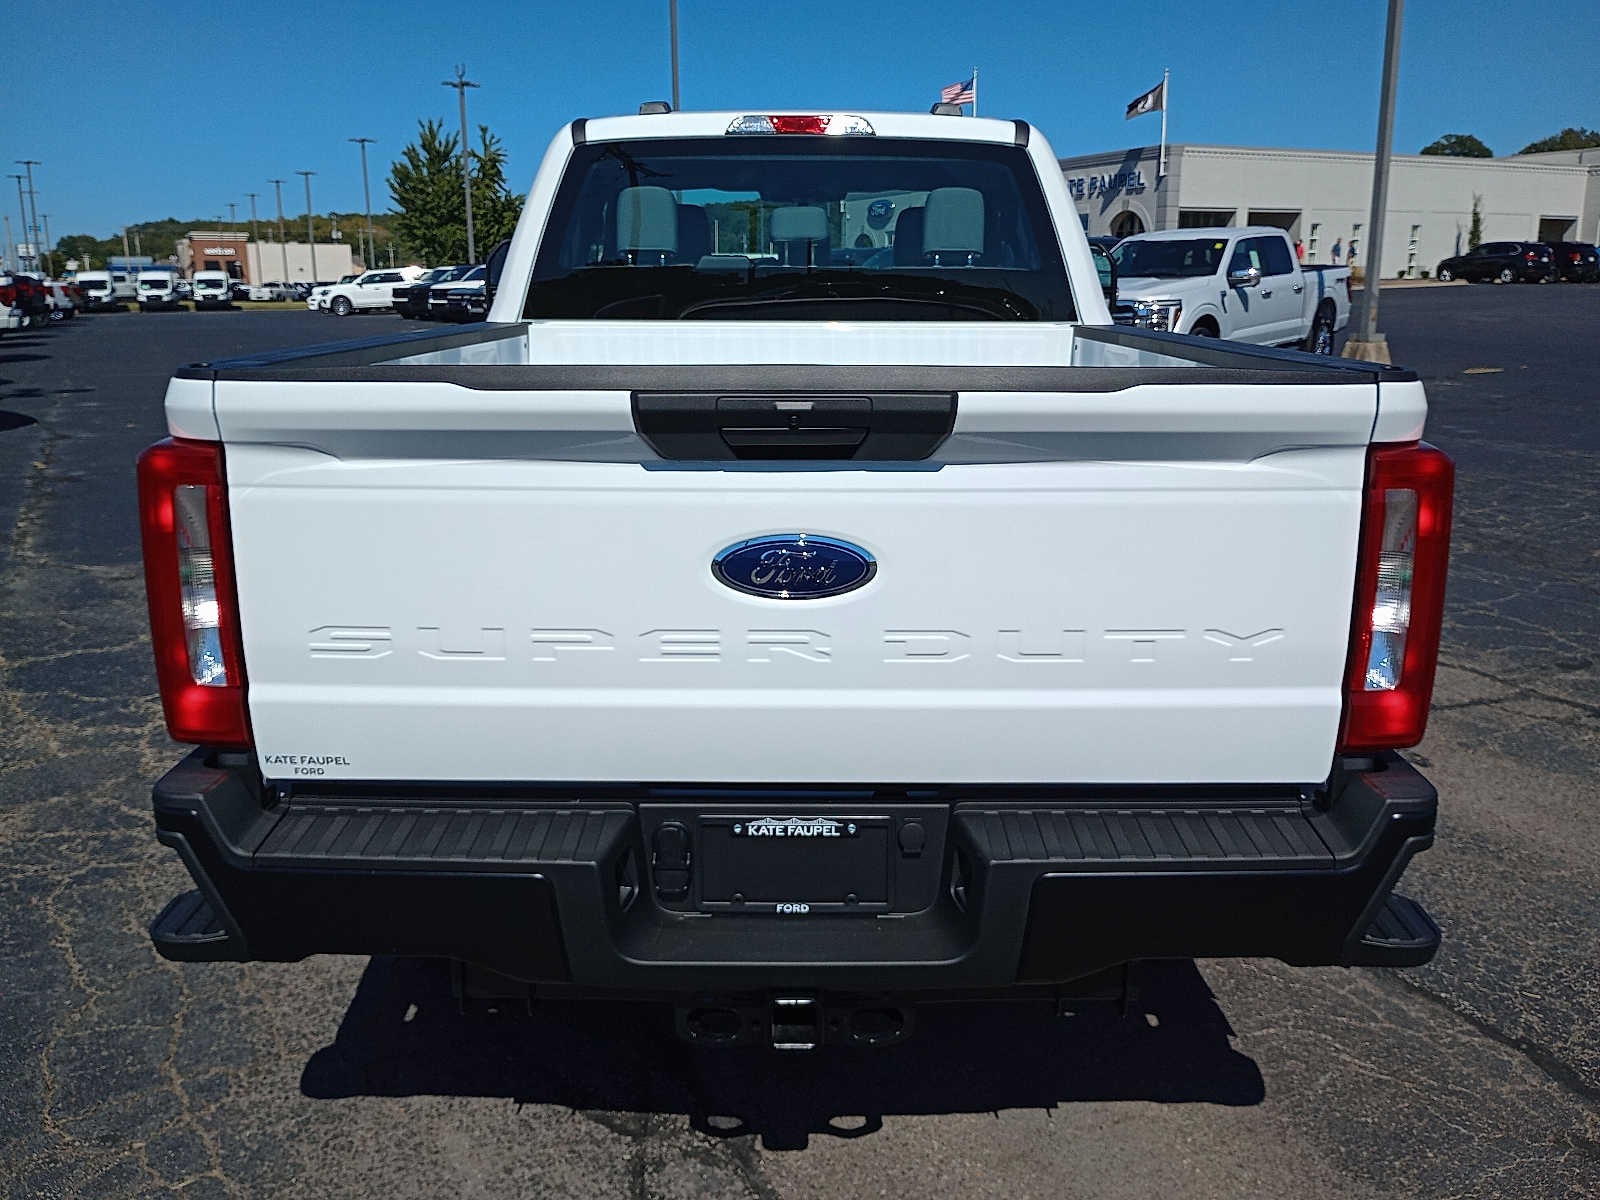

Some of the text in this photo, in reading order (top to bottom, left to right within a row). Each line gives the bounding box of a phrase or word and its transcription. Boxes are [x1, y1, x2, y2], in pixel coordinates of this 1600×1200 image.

[1068, 178, 1085, 195] TE
[750, 548, 839, 585] Ford
[308, 624, 1285, 662] SUPER DUTY
[264, 755, 351, 766] KATE FAUPEL
[294, 767, 325, 776] FORD
[747, 825, 841, 836] KATE FAUPEL
[776, 903, 810, 914] FORD
